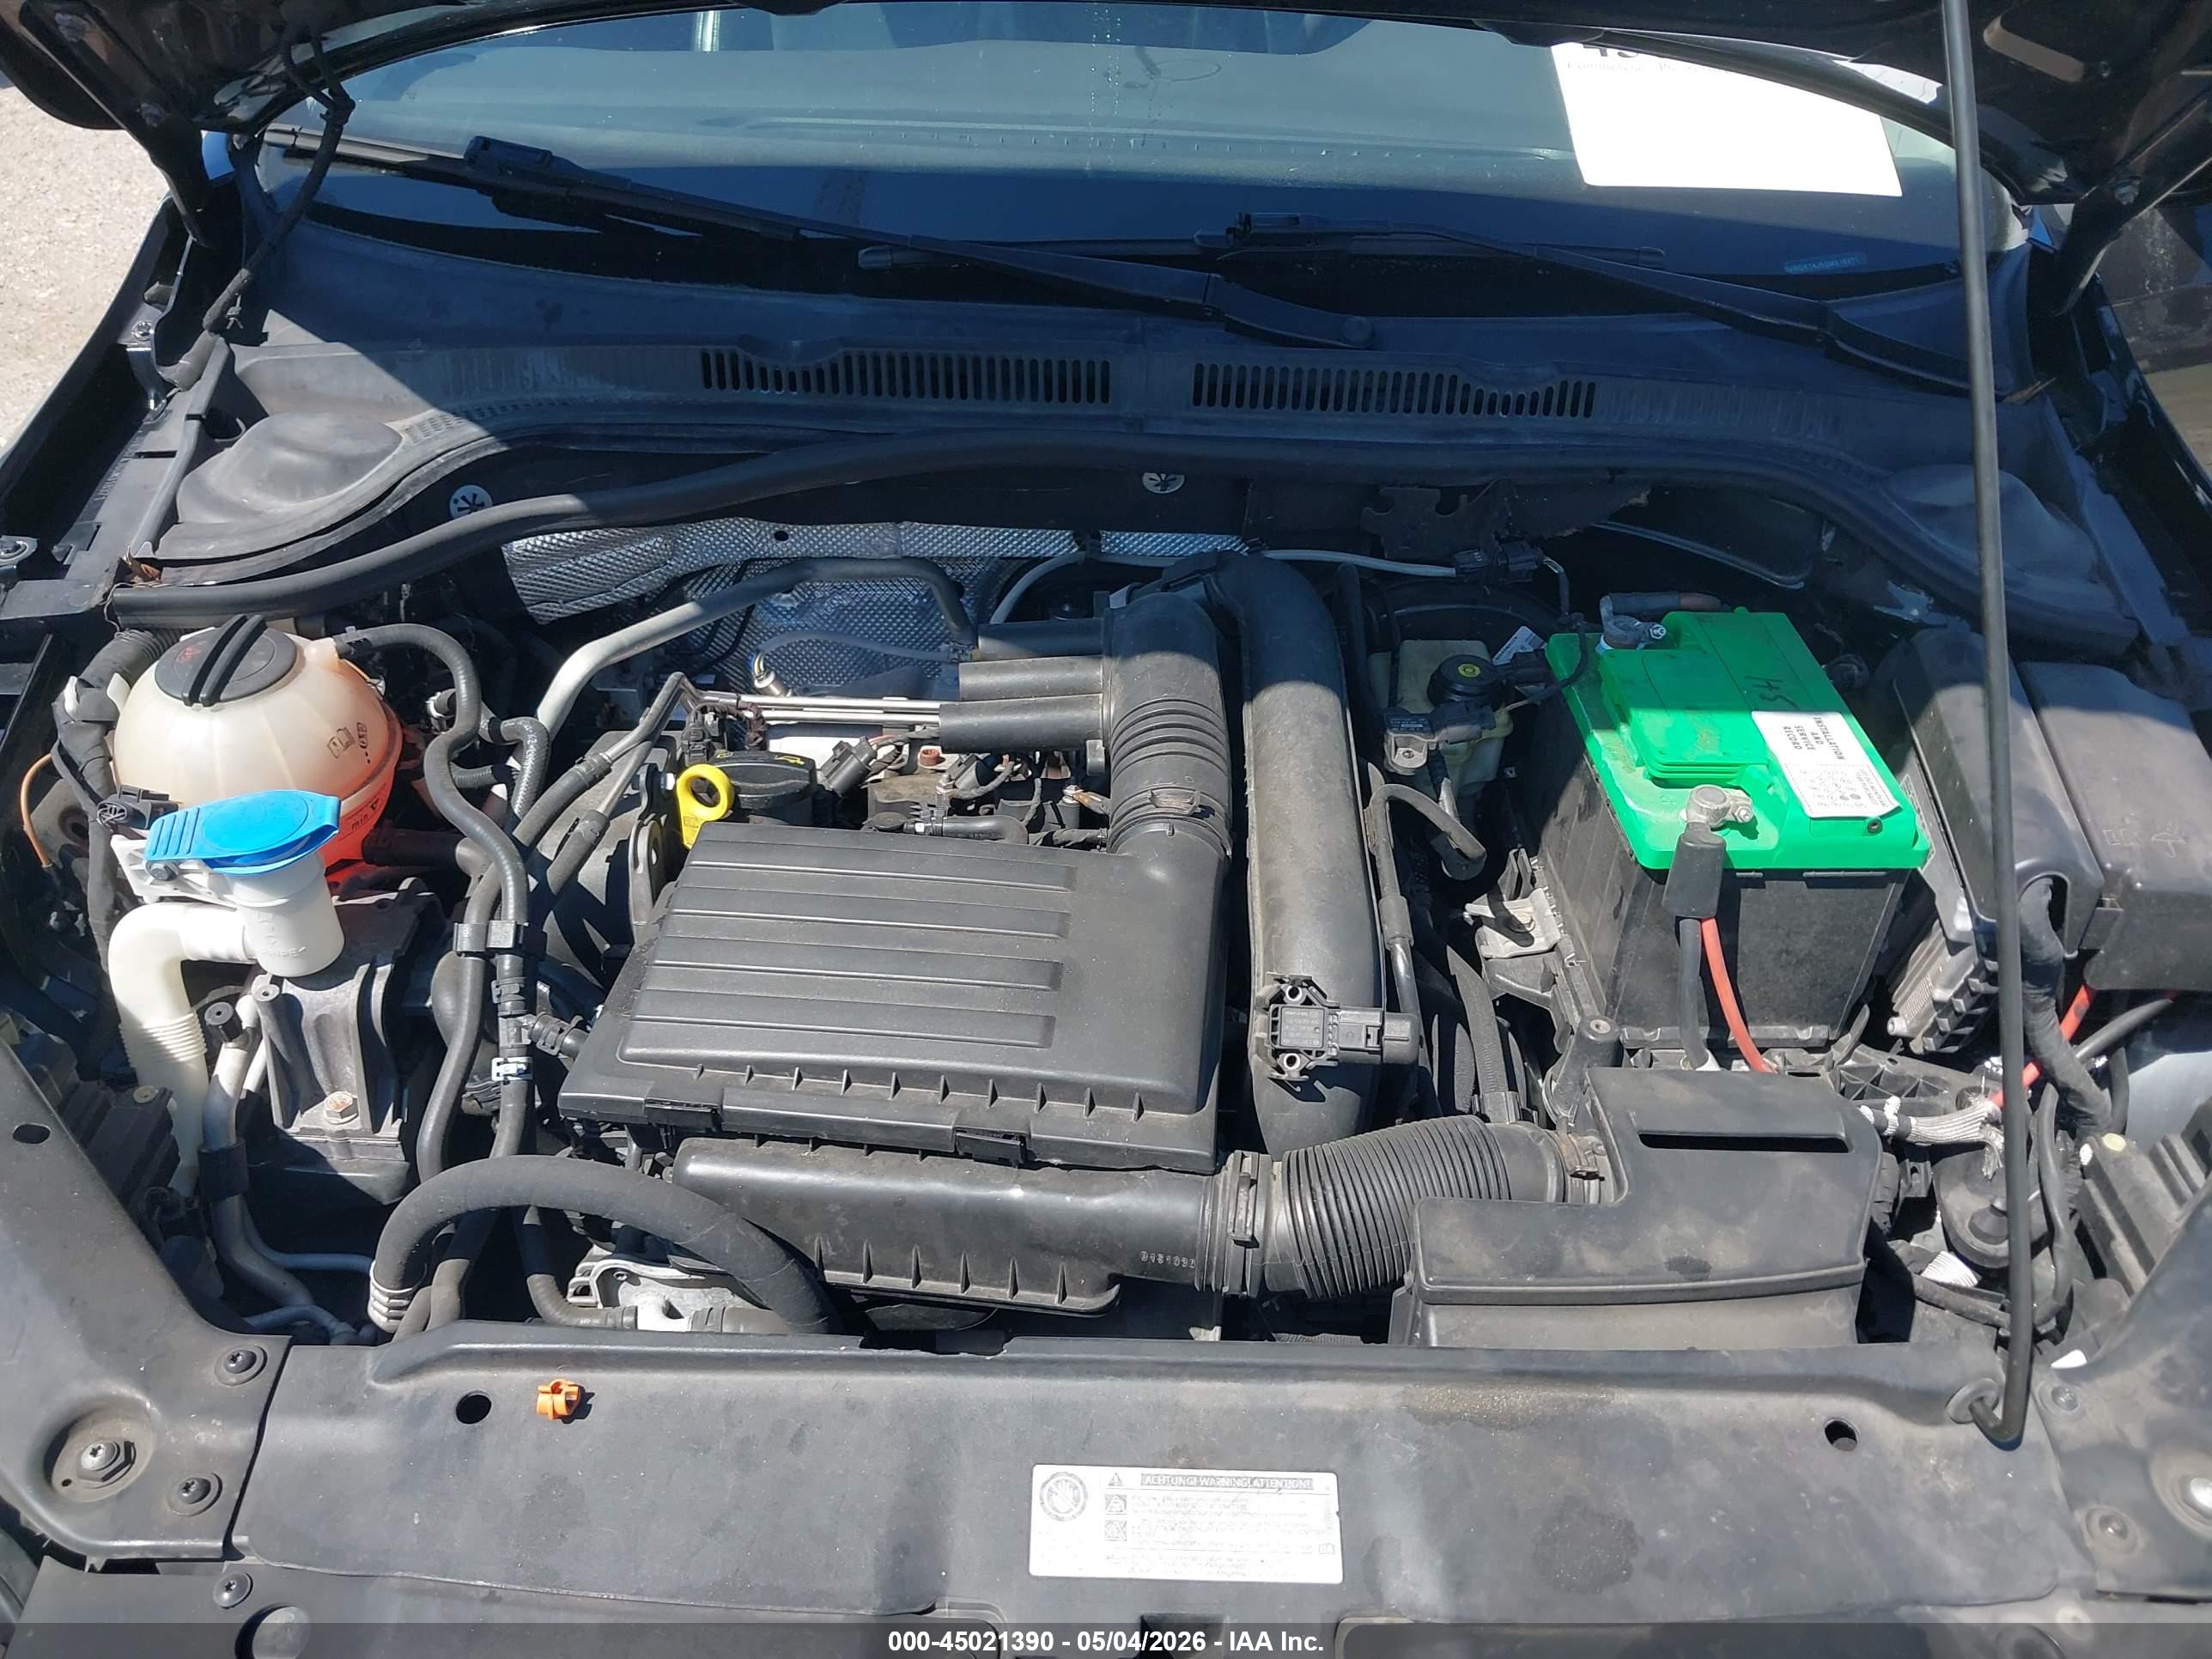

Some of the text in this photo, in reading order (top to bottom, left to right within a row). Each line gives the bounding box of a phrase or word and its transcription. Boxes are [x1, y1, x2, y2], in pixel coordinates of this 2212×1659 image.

[1782, 726, 1803, 750] RECORD
[1794, 725, 1816, 750] SERVICE
[1810, 732, 1824, 744] AND
[1813, 716, 1847, 760] INSTALLATION
[1145, 1473, 1200, 1486] ACHTUNG!
[1200, 1475, 1251, 1488] WARNING!
